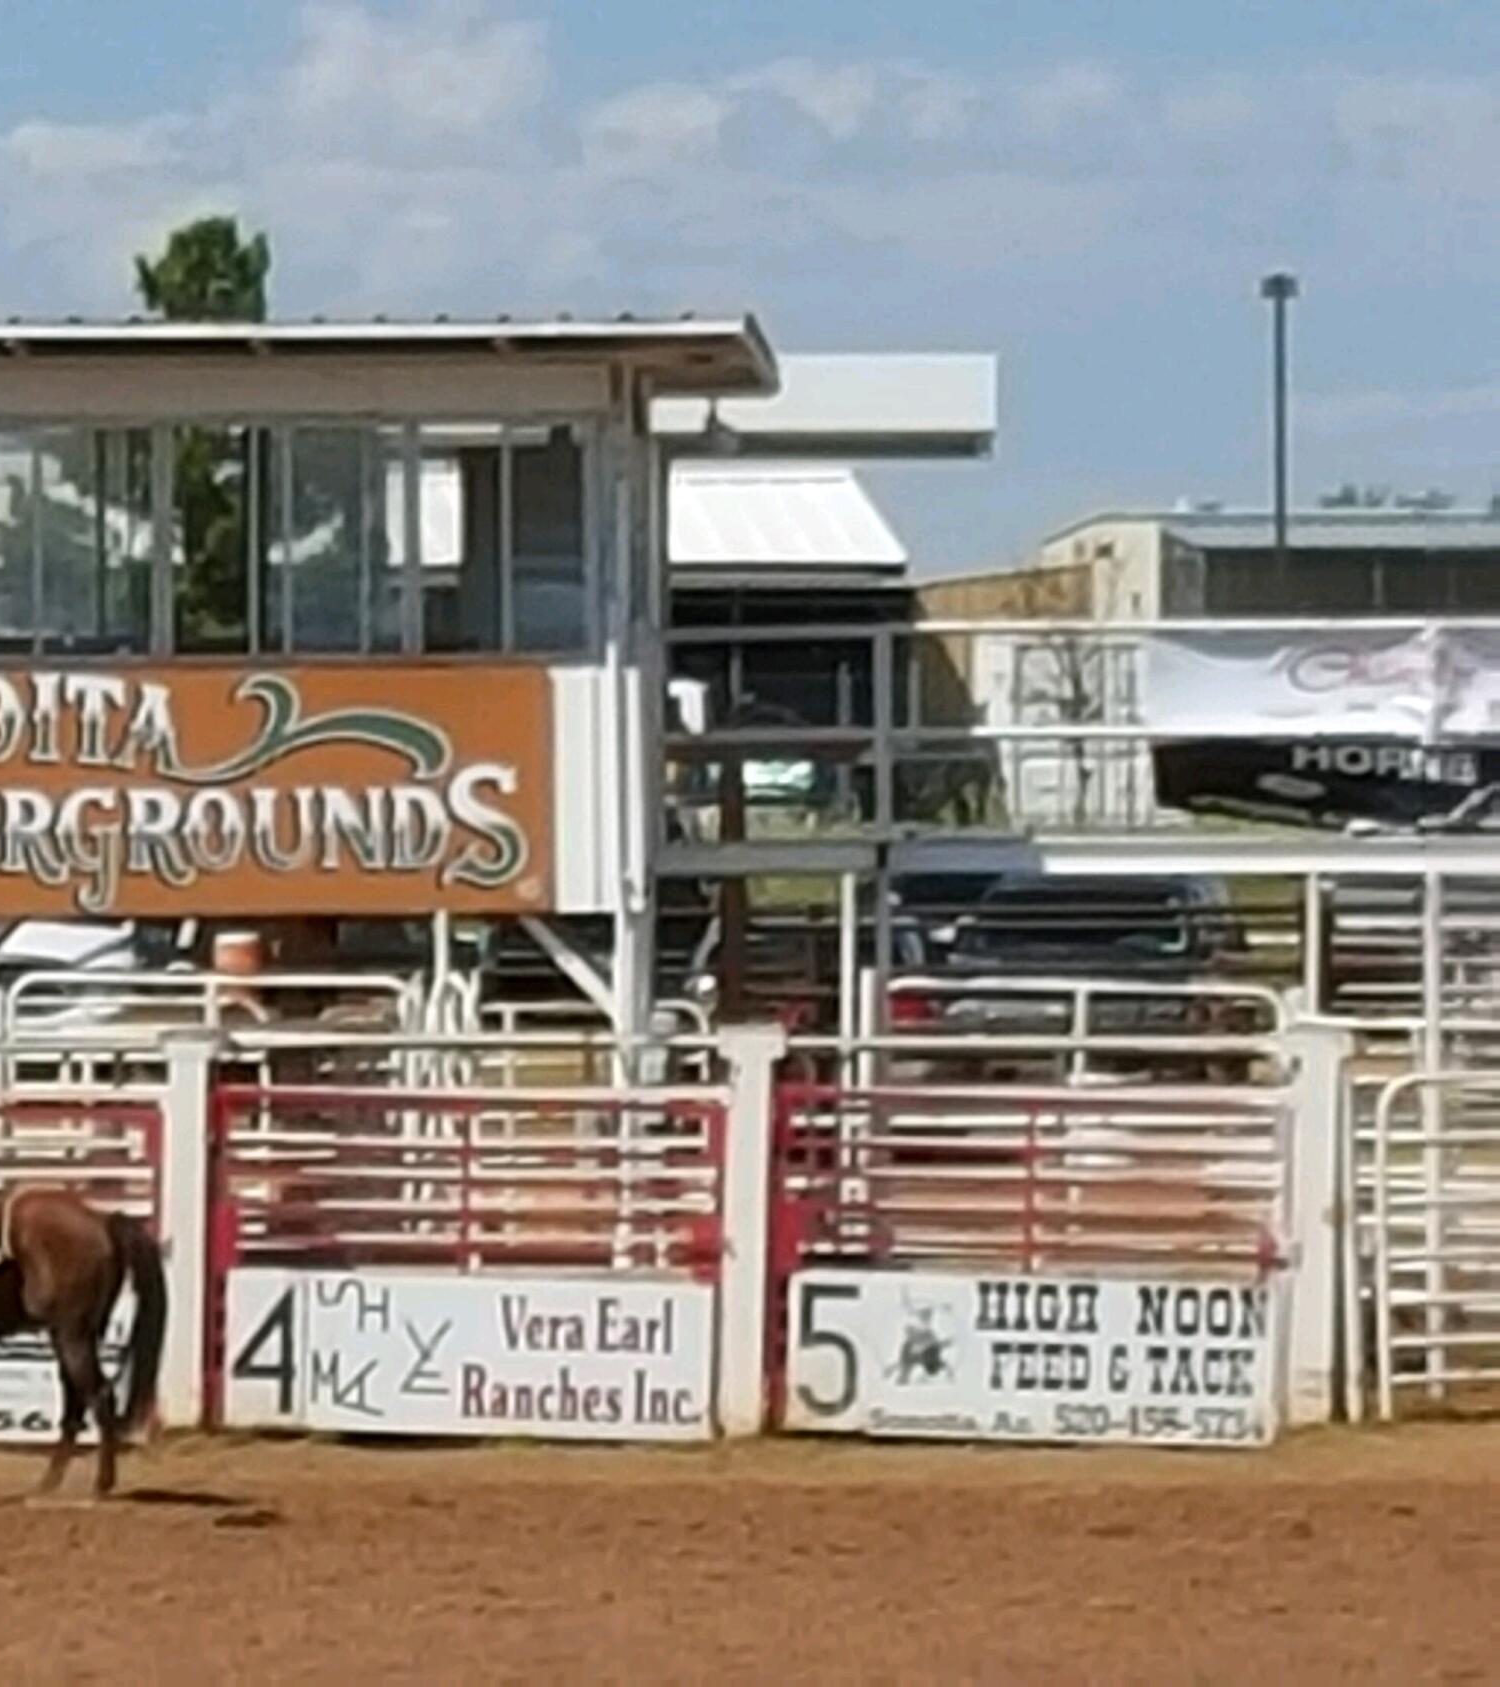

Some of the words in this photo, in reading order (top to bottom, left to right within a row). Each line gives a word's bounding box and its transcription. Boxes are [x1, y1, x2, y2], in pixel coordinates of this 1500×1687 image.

[500, 1295, 585, 1351] Vera
[597, 1299, 673, 1354] Earl
[974, 1281, 1099, 1333] HIGH
[1136, 1286, 1267, 1338] NOON
[232, 1284, 297, 1413] 4
[798, 1283, 860, 1416] 5
[989, 1343, 1090, 1391] FEED
[1145, 1345, 1256, 1397] TACK
[461, 1363, 623, 1424] Ranches
